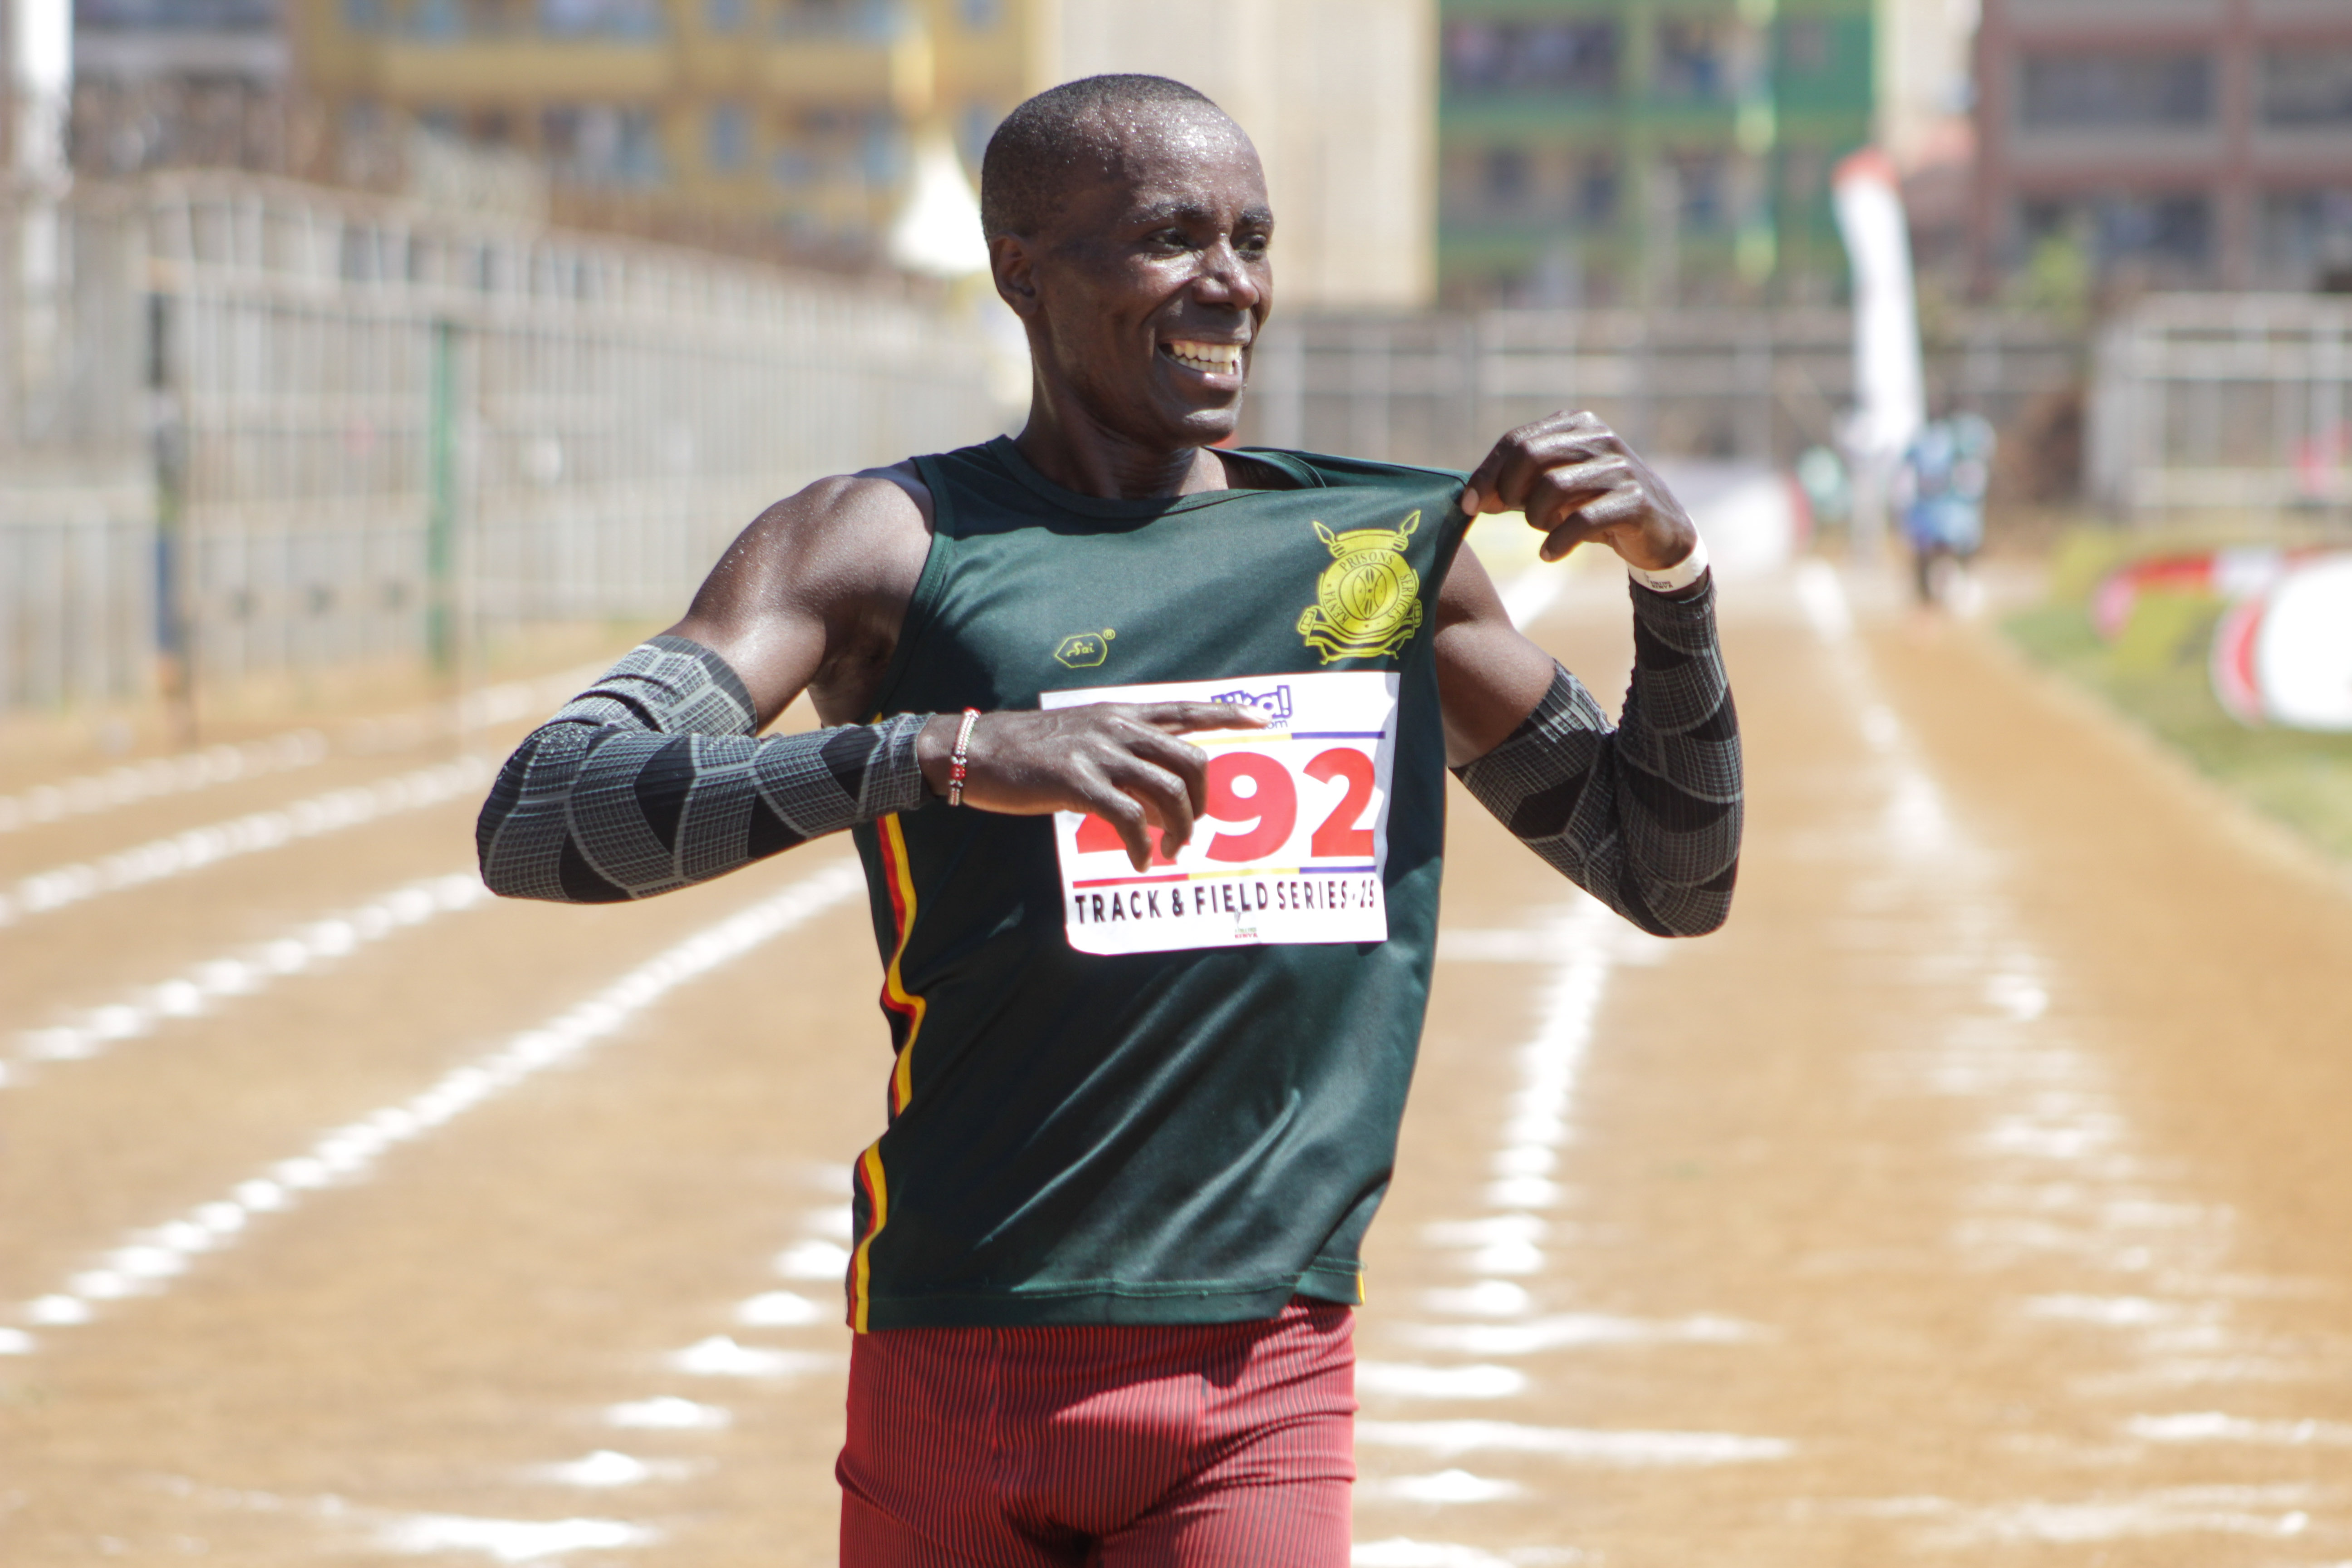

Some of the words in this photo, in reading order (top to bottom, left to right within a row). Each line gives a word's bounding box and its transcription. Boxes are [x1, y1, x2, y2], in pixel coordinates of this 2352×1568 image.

[1324, 591, 1349, 624] KENYA
[1339, 551, 1395, 572] PRISONS
[1387, 573, 1414, 622] SERVICES
[1075, 890, 1163, 924] TRACK
[1172, 888, 1185, 918] &
[1194, 881, 1269, 915] FIELD
